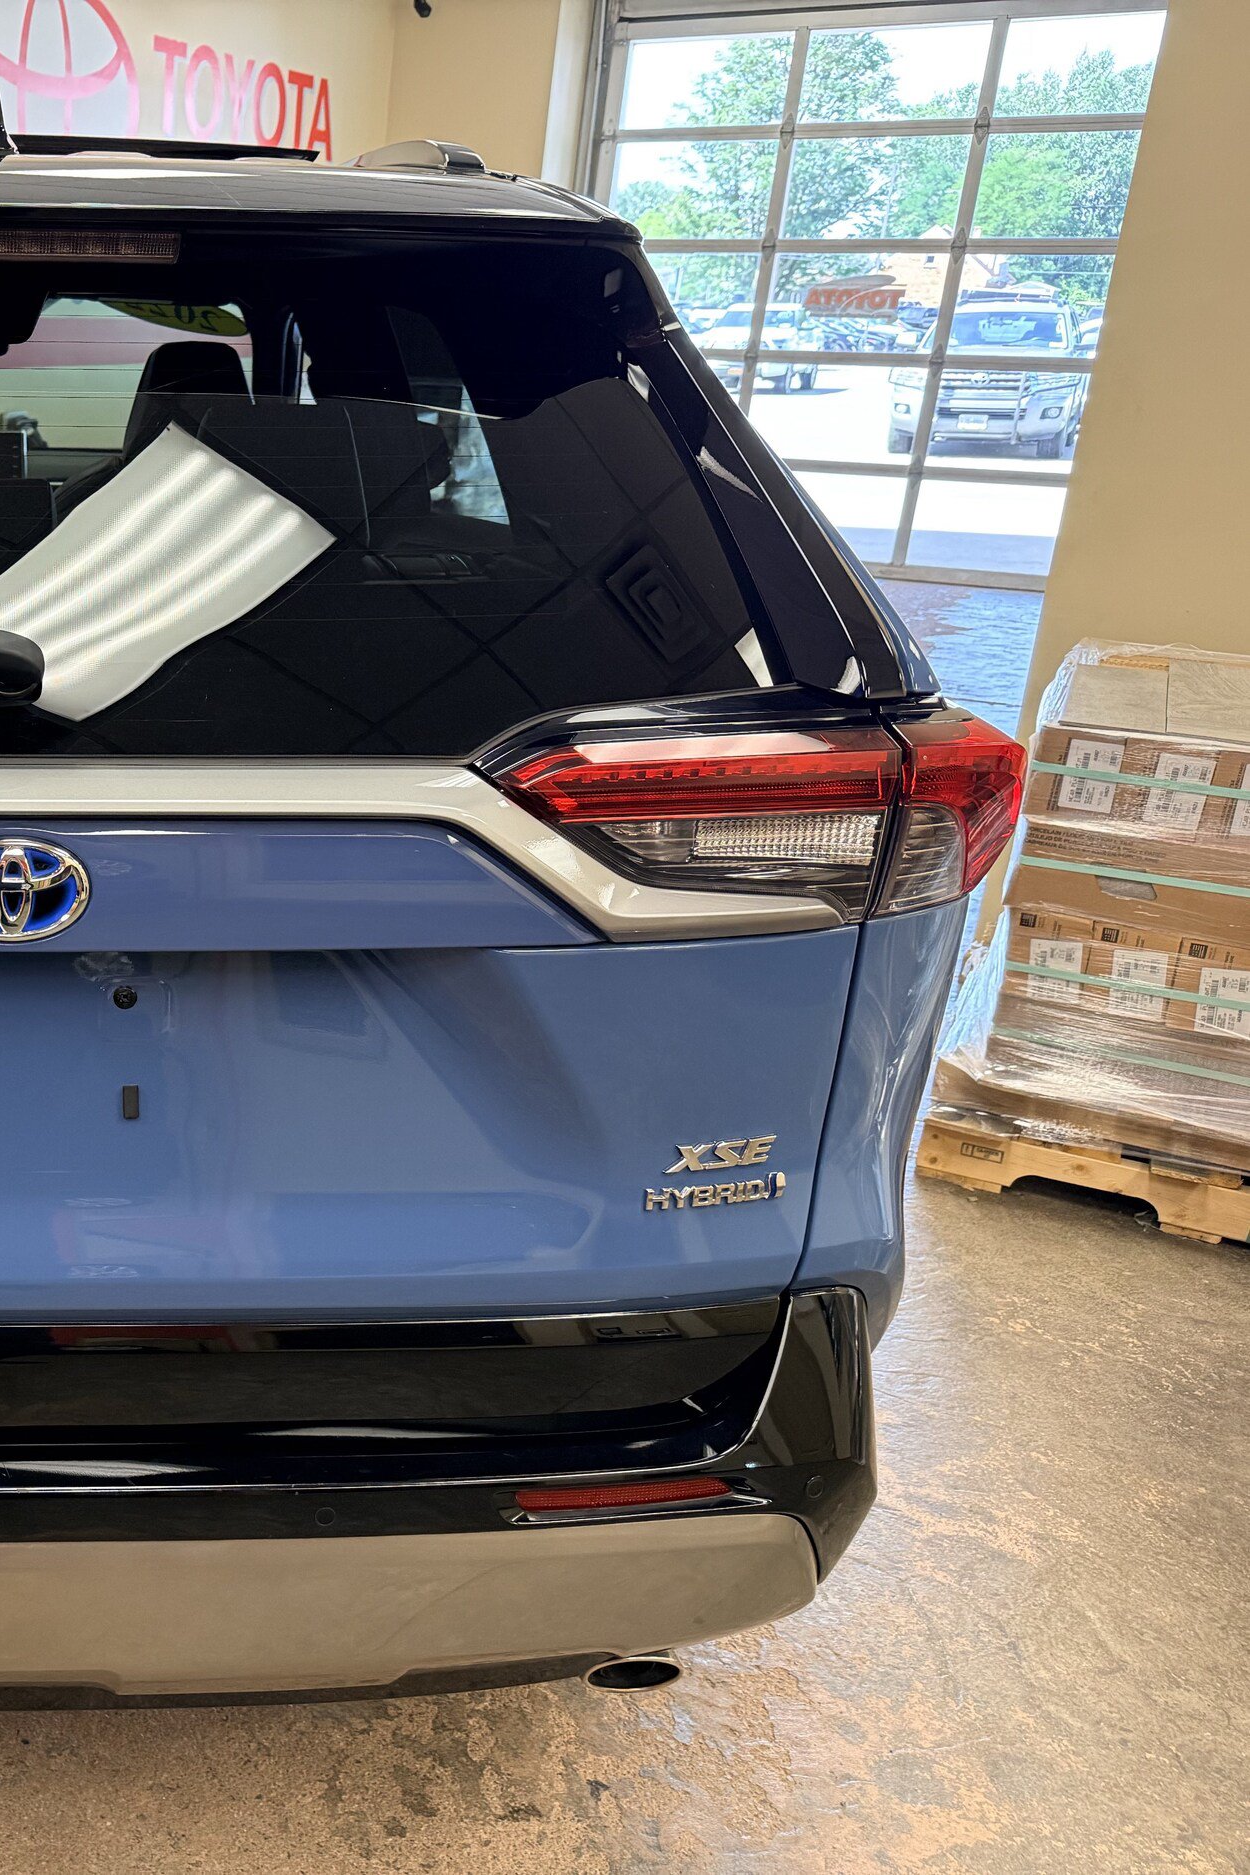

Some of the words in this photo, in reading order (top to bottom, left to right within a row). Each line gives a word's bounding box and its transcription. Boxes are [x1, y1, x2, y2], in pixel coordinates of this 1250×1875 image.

[153, 34, 332, 162] TOYOTA
[661, 1133, 778, 1174] XSE
[644, 1178, 766, 1211] HYBRID
